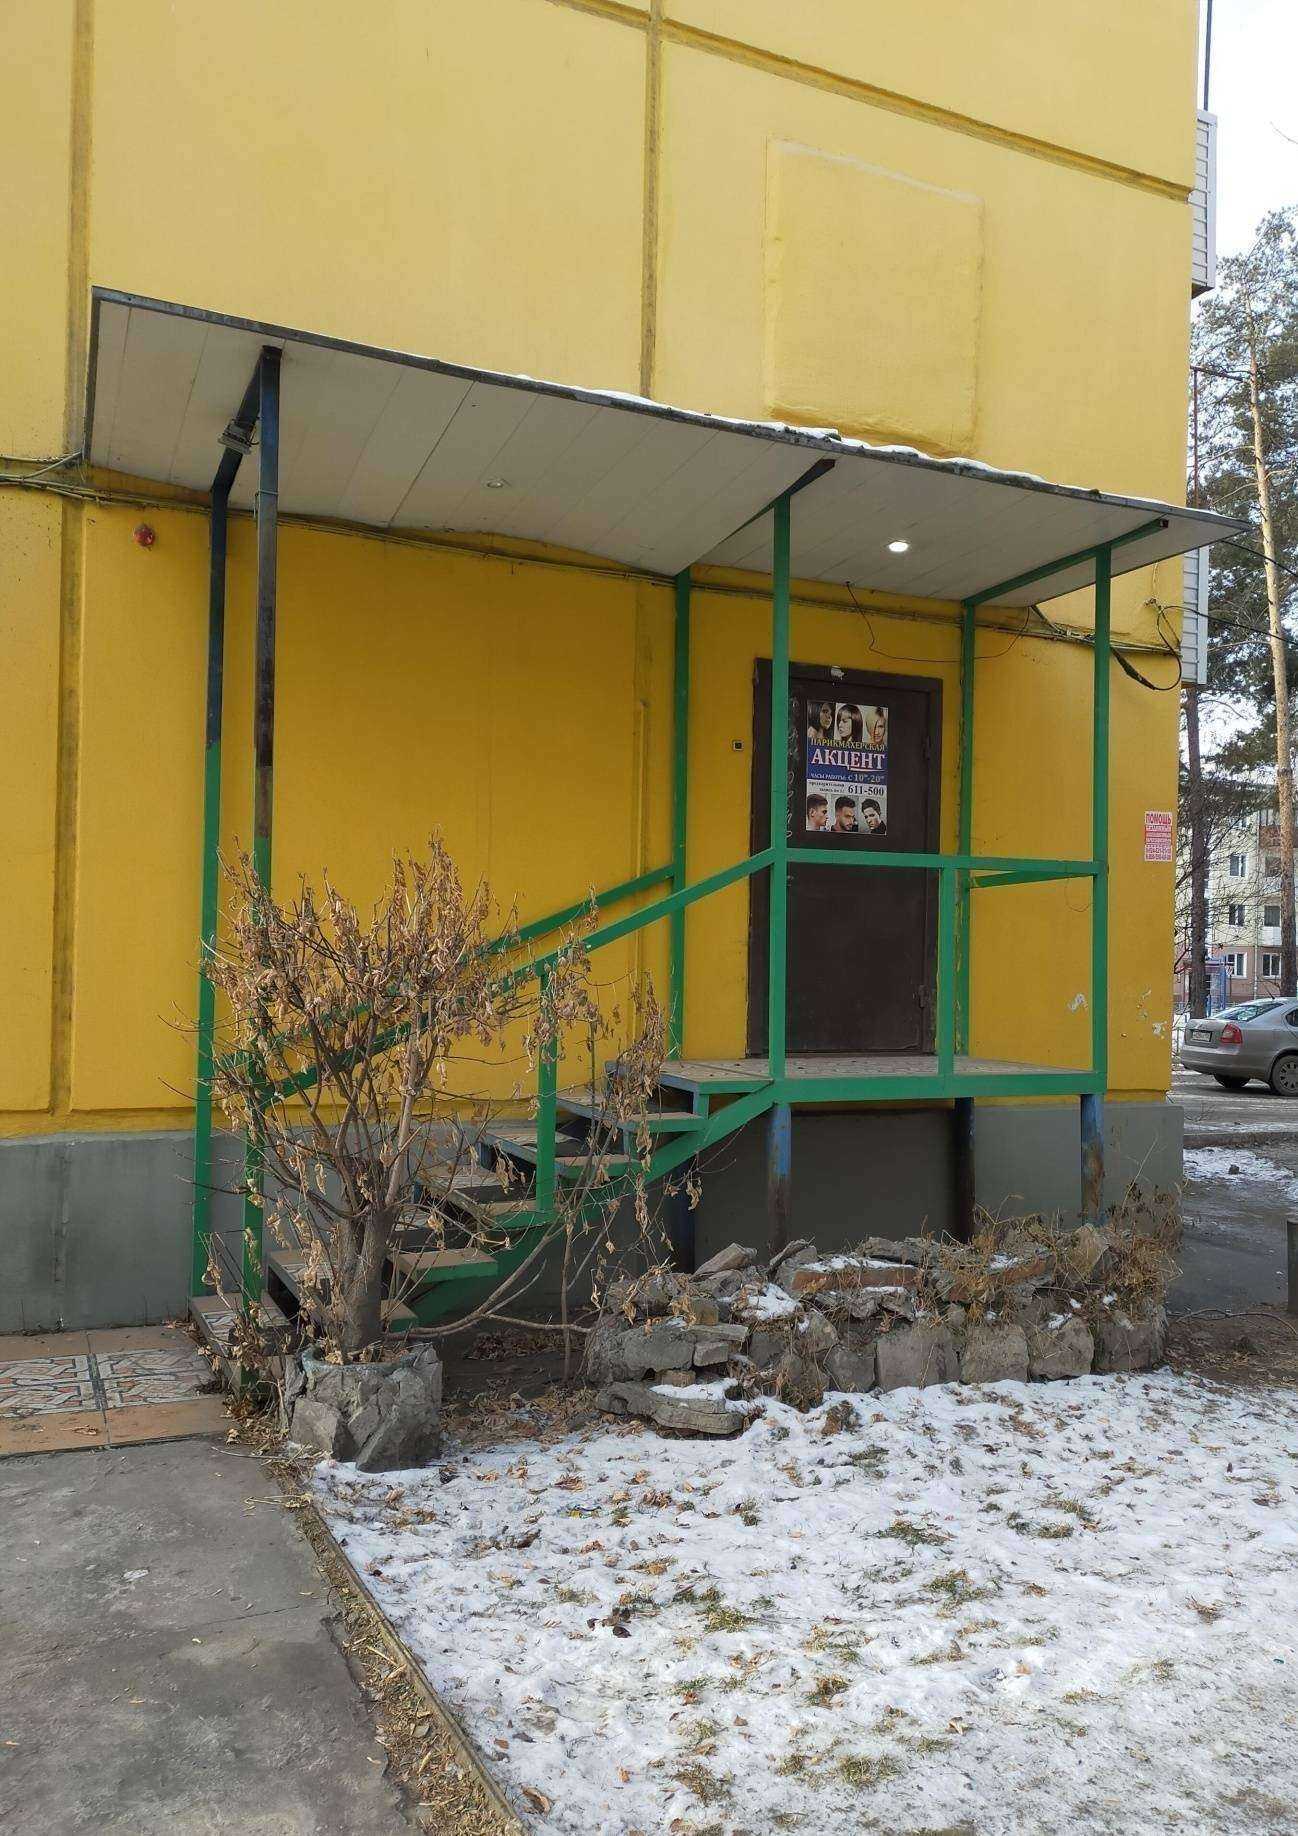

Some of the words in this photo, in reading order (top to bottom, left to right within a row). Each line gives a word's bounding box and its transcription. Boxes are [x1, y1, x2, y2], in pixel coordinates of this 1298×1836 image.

[811, 738, 885, 752] ПАРИКМАХЕРСКАЯ
[811, 748, 885, 770] АКЦЕНТ
[848, 785, 884, 796] 611-500
[1146, 814, 1172, 825] ПОМОЩЬ
